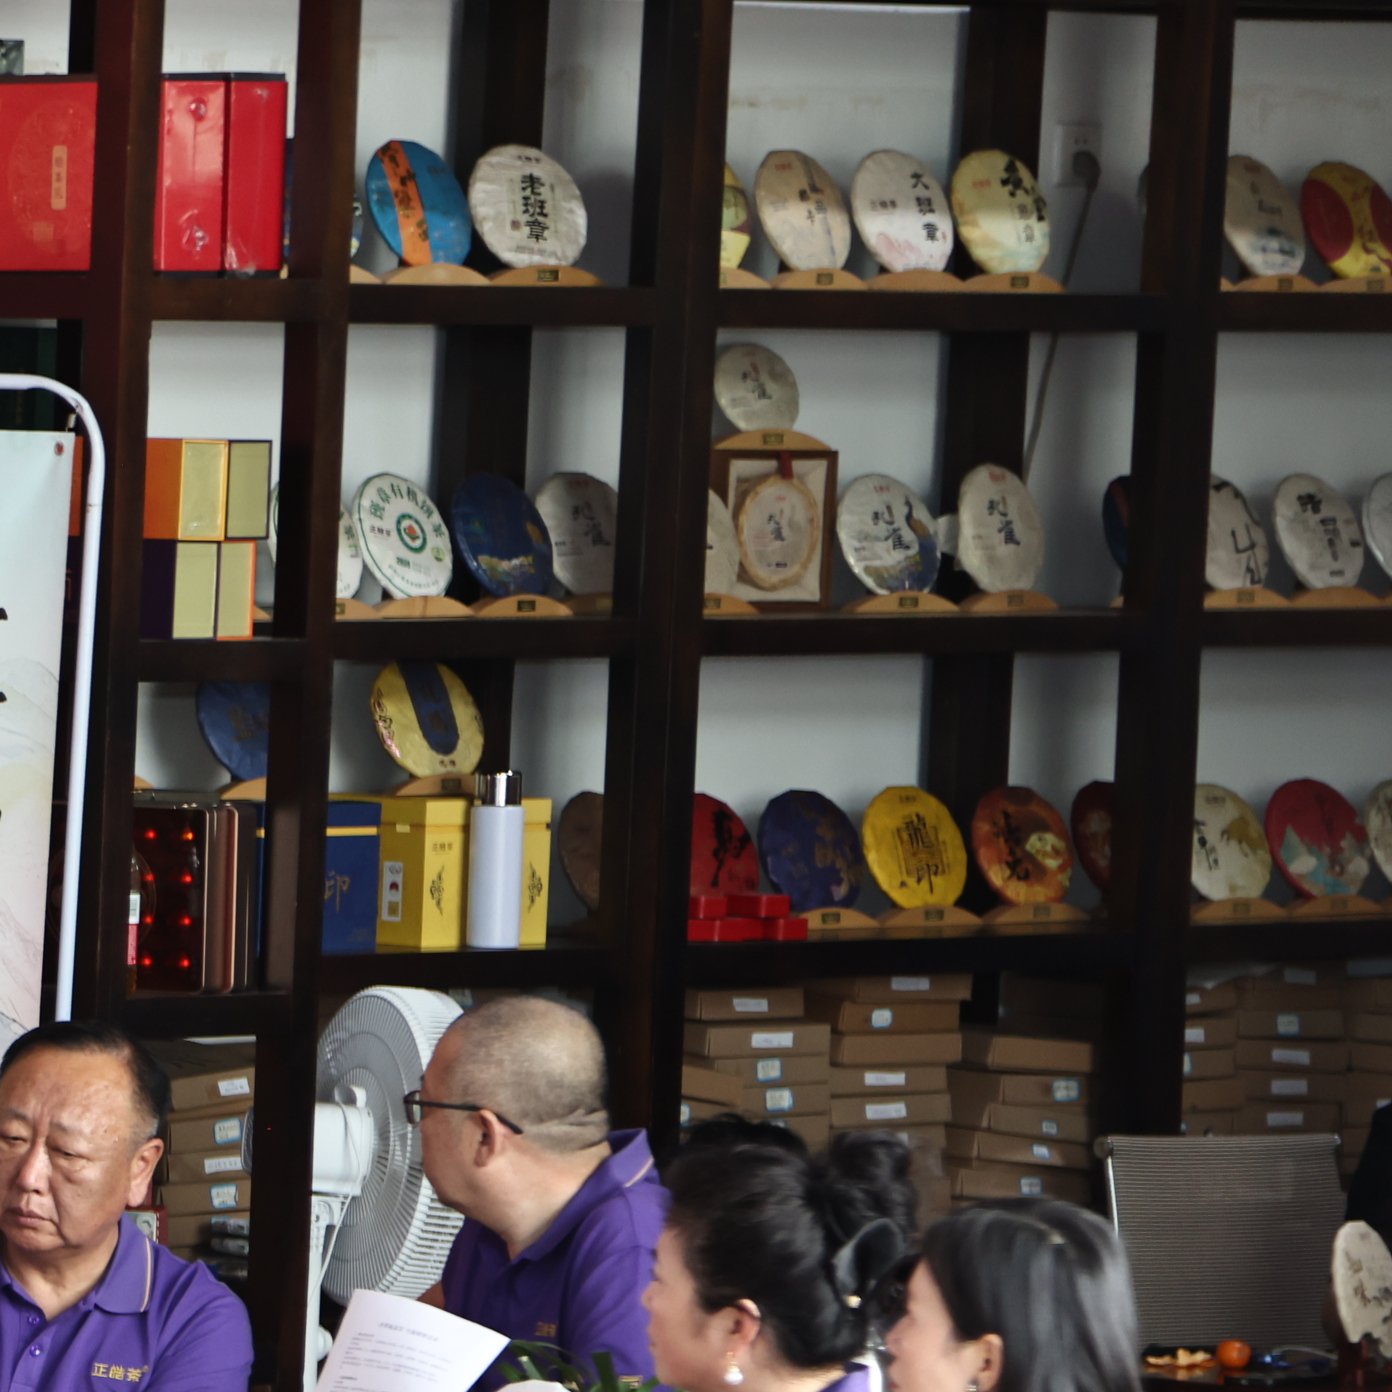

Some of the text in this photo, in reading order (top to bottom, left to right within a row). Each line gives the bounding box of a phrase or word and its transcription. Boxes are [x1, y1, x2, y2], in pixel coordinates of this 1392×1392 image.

[520, 172, 550, 243] 老班章
[910, 171, 940, 242] 大班章
[91, 1361, 143, 1383] 正皓茶
